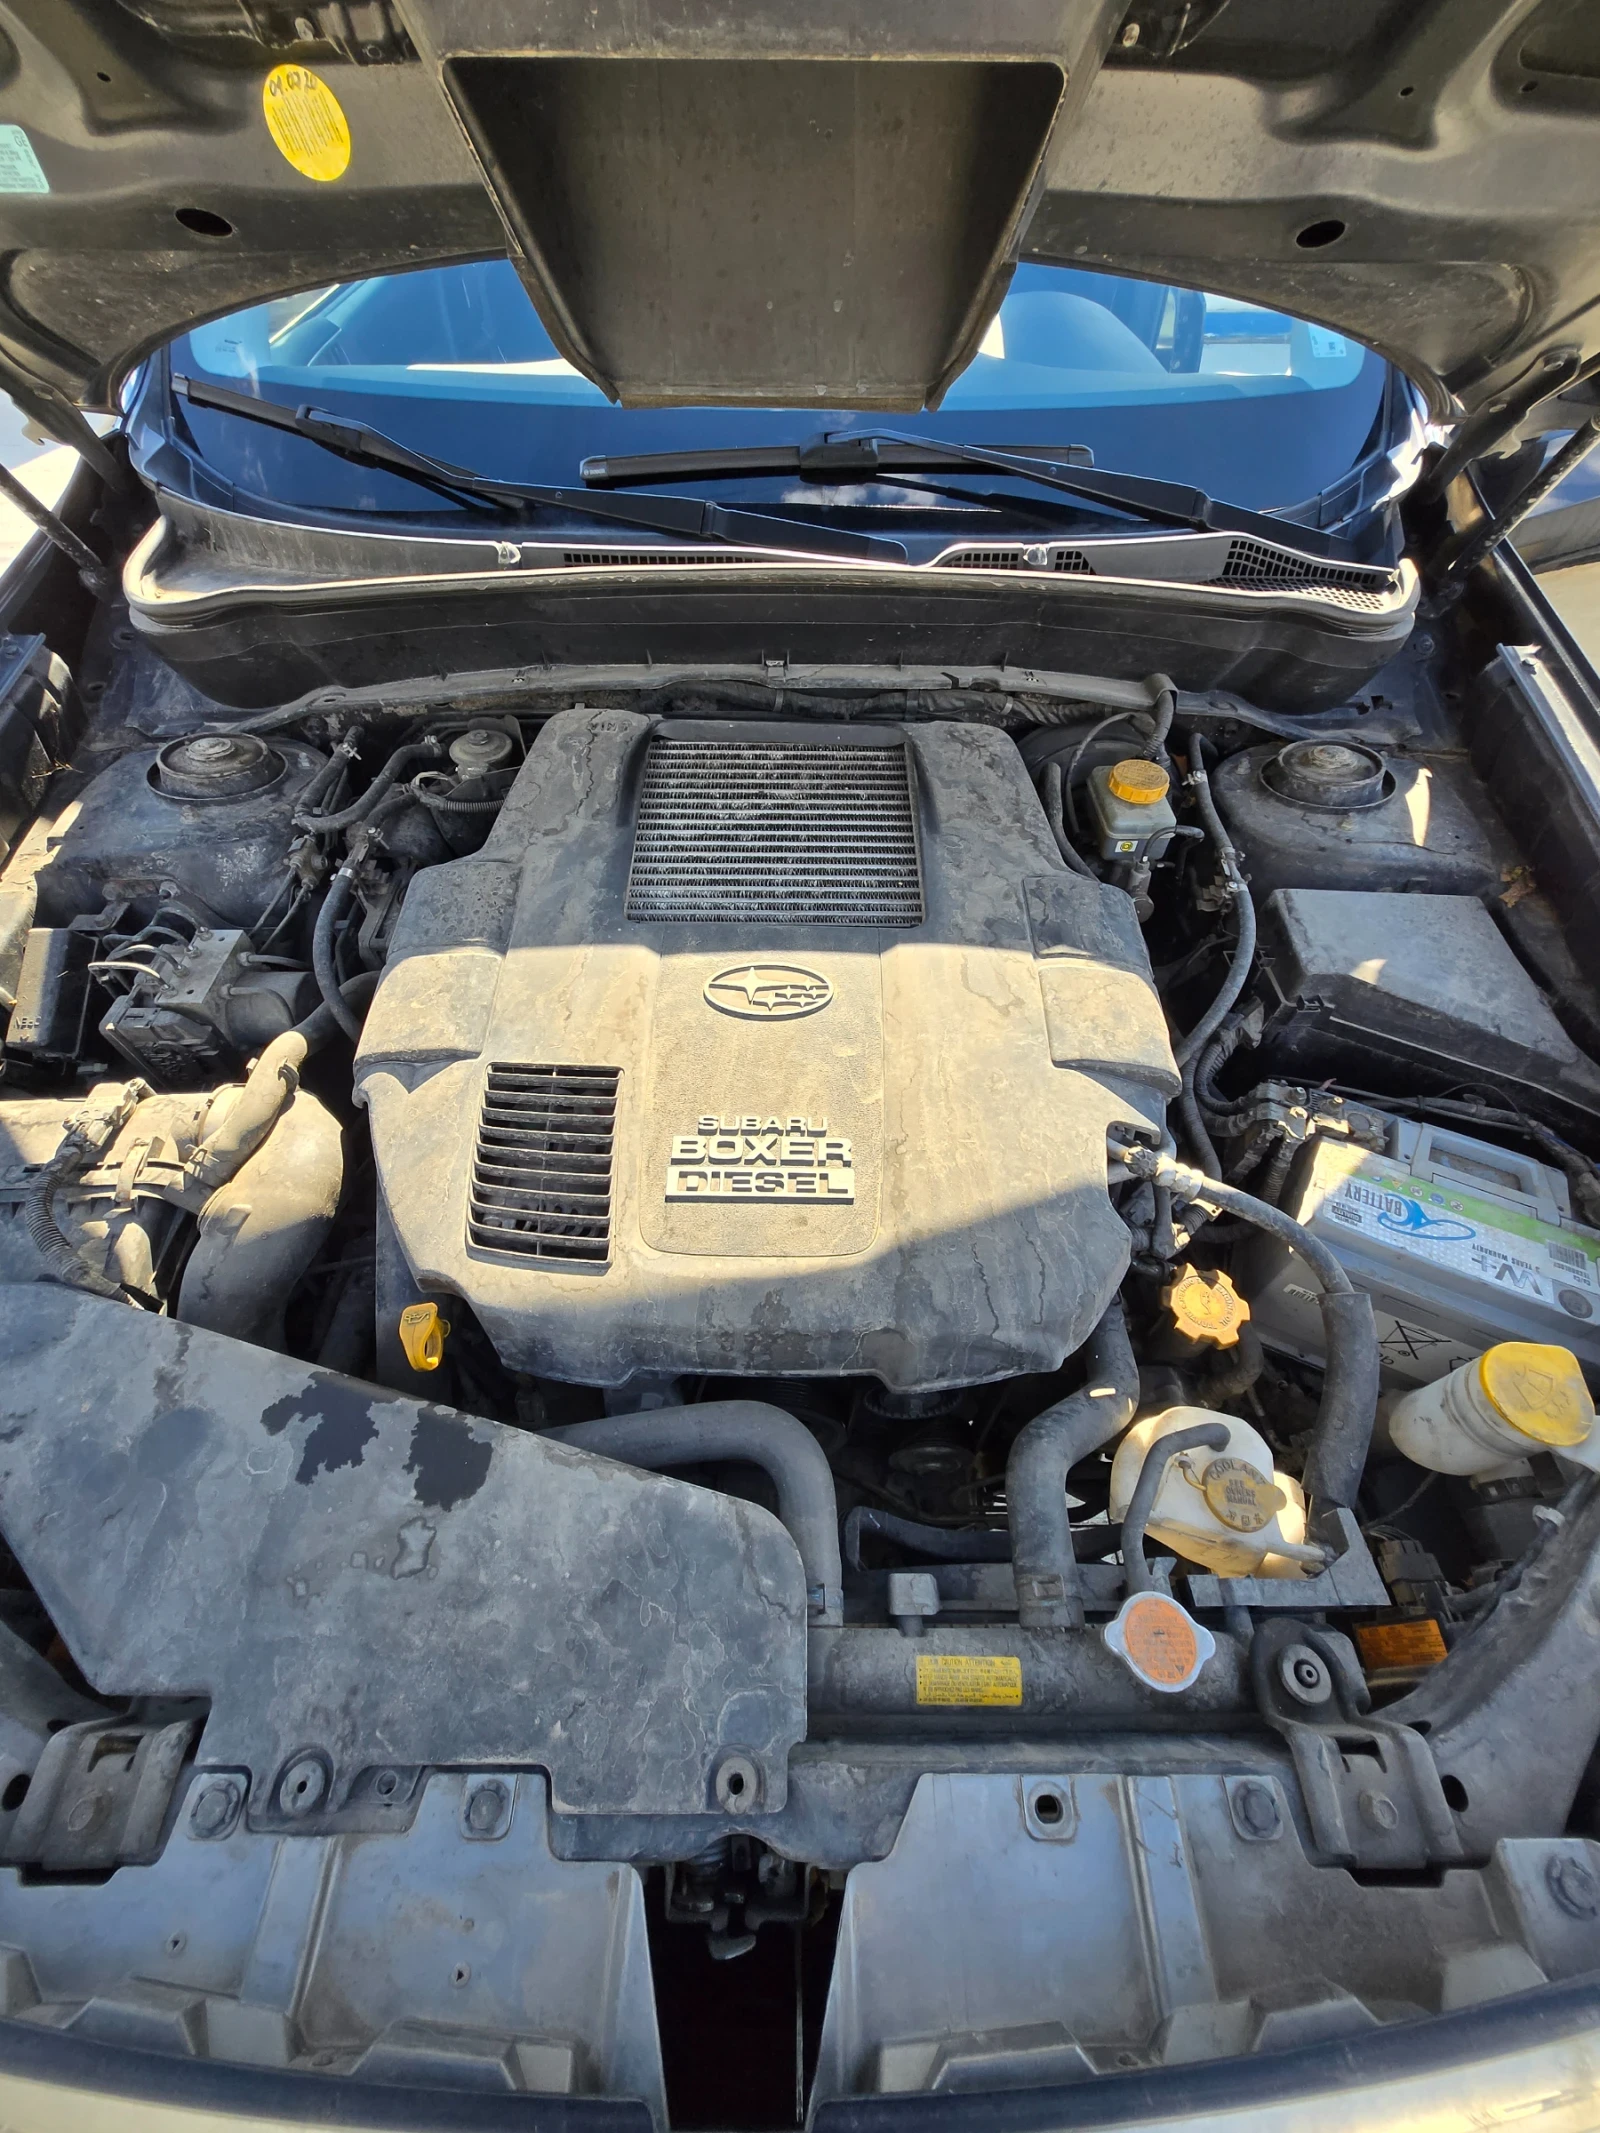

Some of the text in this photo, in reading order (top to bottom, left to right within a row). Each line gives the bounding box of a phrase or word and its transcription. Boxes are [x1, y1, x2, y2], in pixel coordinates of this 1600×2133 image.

[698, 1115, 828, 1137] SUBARU
[671, 1135, 852, 1167] BOXER
[676, 1170, 849, 1194] DIESEL
[1344, 1183, 1403, 1217] BATTERY
[1471, 1243, 1509, 1261] WARRANTY
[1511, 1257, 1533, 1271] YEARS
[965, 1658, 996, 1667] ATTENTION
